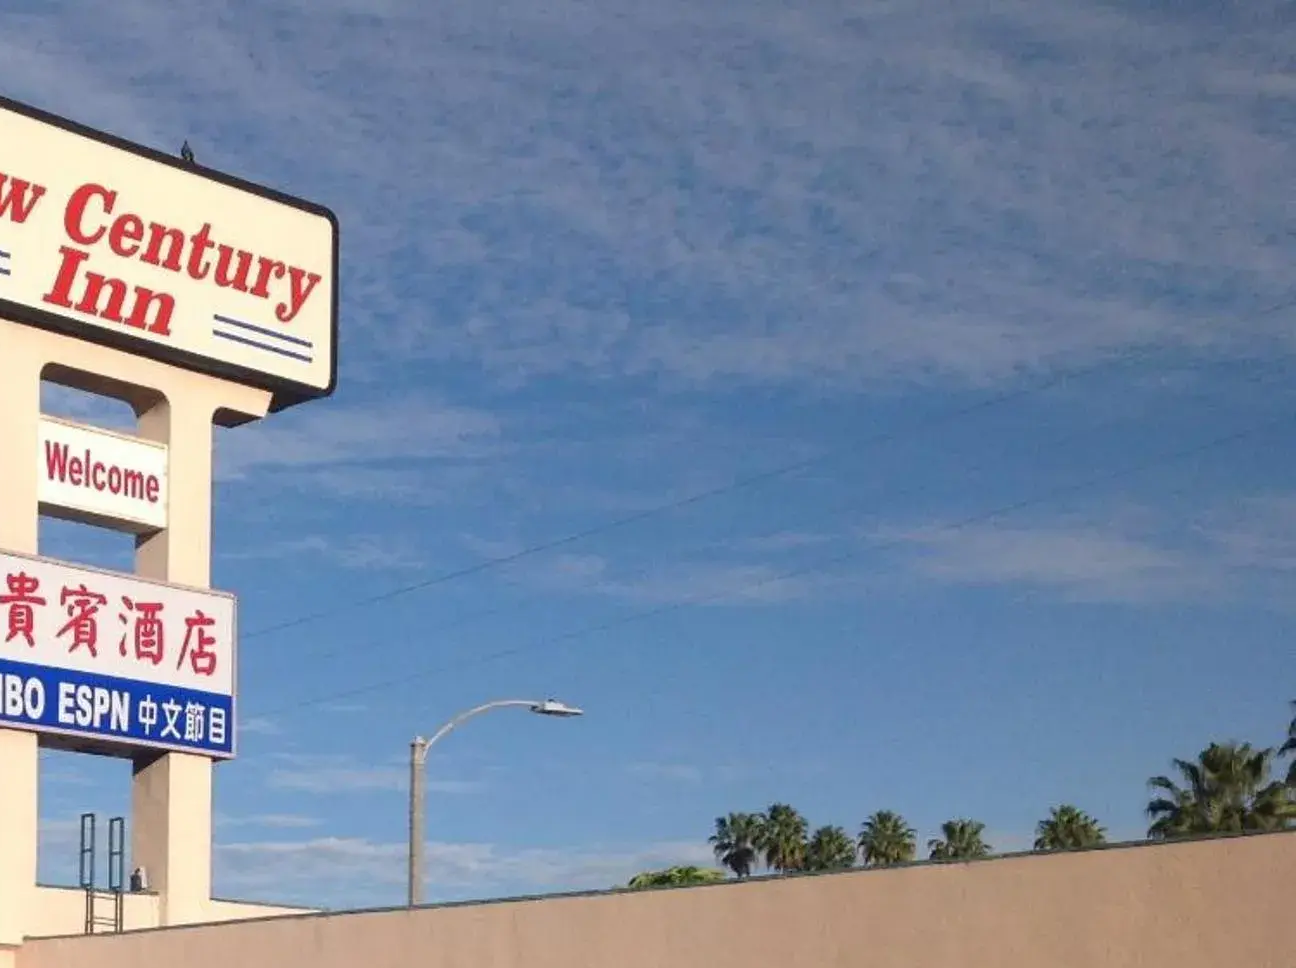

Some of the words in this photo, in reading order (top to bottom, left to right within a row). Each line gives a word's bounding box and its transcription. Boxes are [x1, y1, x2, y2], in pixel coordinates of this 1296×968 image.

[43, 245, 178, 337] Inn
[64, 182, 322, 323] Century
[44, 439, 160, 503] Welcome
[58, 681, 130, 732] ESPN
[138, 694, 226, 744] 中文節目
